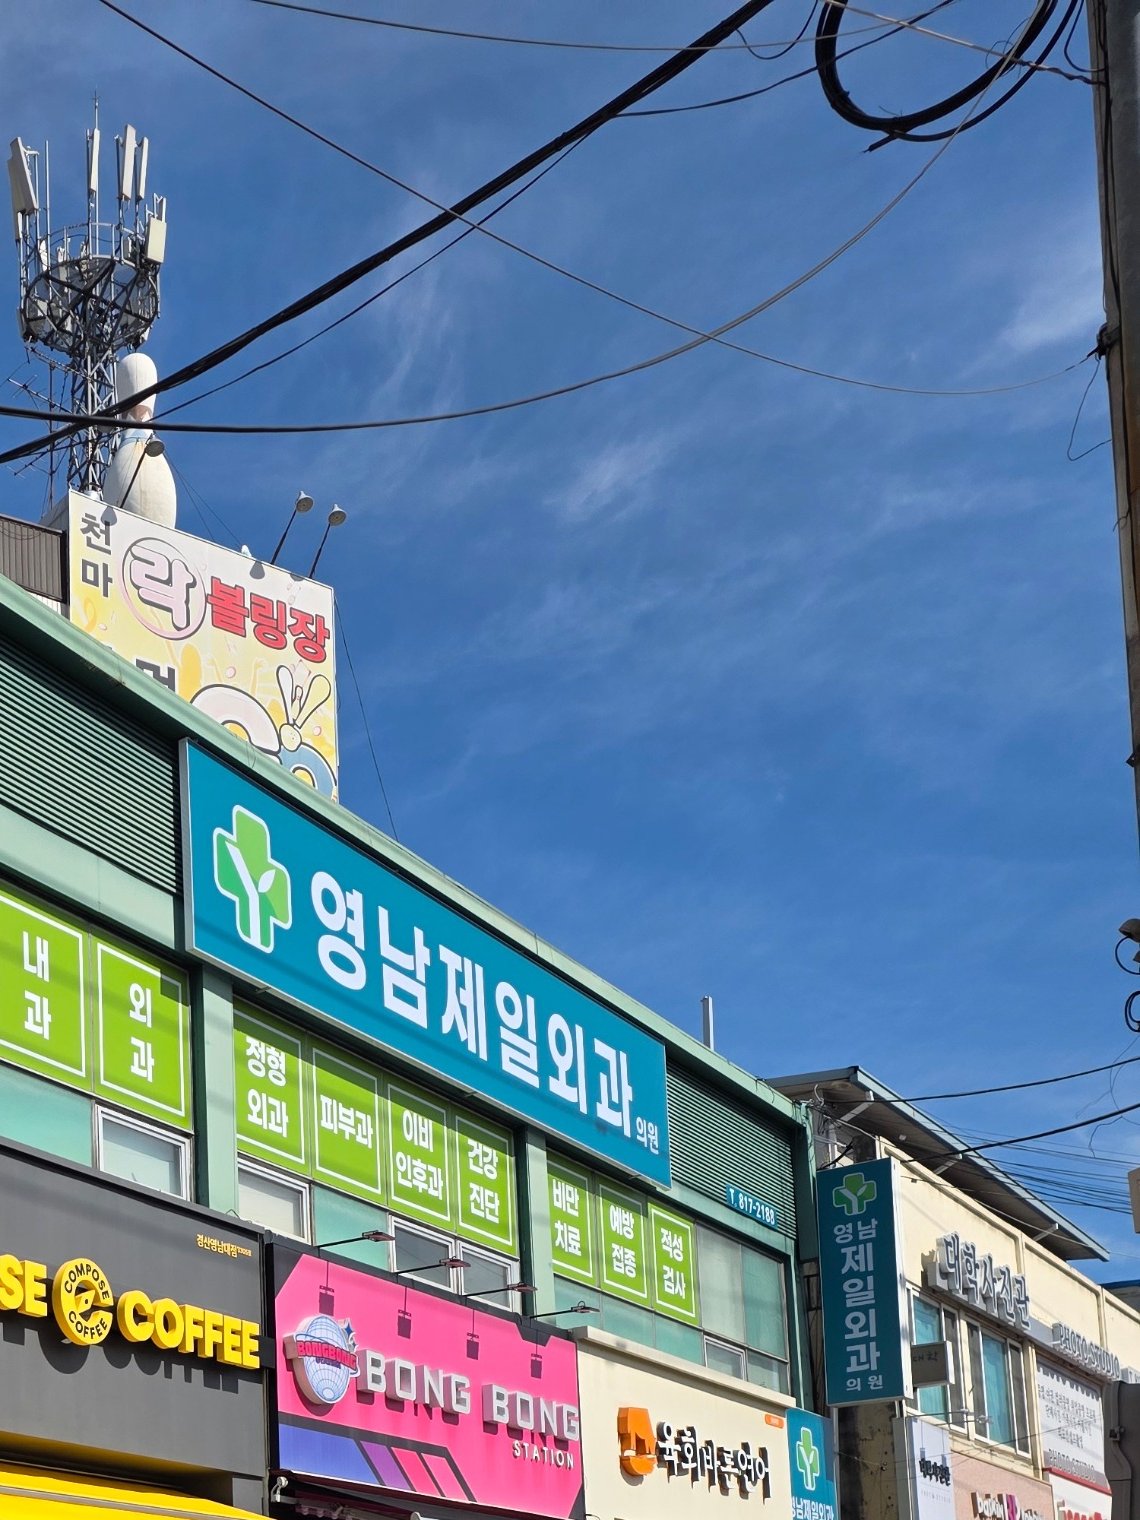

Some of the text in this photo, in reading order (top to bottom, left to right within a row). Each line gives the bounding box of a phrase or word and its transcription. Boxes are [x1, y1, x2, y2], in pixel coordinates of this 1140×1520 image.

[80, 512, 112, 598] 천마
[128, 551, 330, 663] 락 볼링장
[311, 871, 659, 1155] 영남제일외과 의원
[246, 1036, 286, 1087] 정형
[247, 1089, 288, 1138] 외과
[320, 1094, 373, 1148] 피부과
[402, 1110, 433, 1152] 이비
[396, 1152, 443, 1200] 인후과
[467, 1139, 498, 1180] 건강
[469, 1182, 499, 1223] 진단
[552, 1179, 579, 1217] 비만
[738, 1194, 775, 1225] 817-2188
[555, 1221, 581, 1257] 치료
[610, 1205, 634, 1240] 예방
[834, 1218, 878, 1244] 영남
[196, 1233, 238, 1259] 경산영남대점
[612, 1243, 636, 1278] 접종
[661, 1228, 683, 1261] 적성
[64, 1263, 110, 1301] COMPOSE
[663, 1266, 685, 1299] 검사
[943, 1232, 1031, 1331] 대학사진관
[68, 1310, 109, 1340] COFFEE
[840, 1243, 881, 1373] 제일외과
[117, 1290, 260, 1369] COFFEE
[1059, 1323, 1120, 1380] PHOTO STUDIO
[358, 1348, 580, 1442] BONG BONG
[846, 1375, 883, 1391] 의원
[513, 1439, 574, 1469] STATION
[657, 1421, 771, 1499] 육회바른연어
